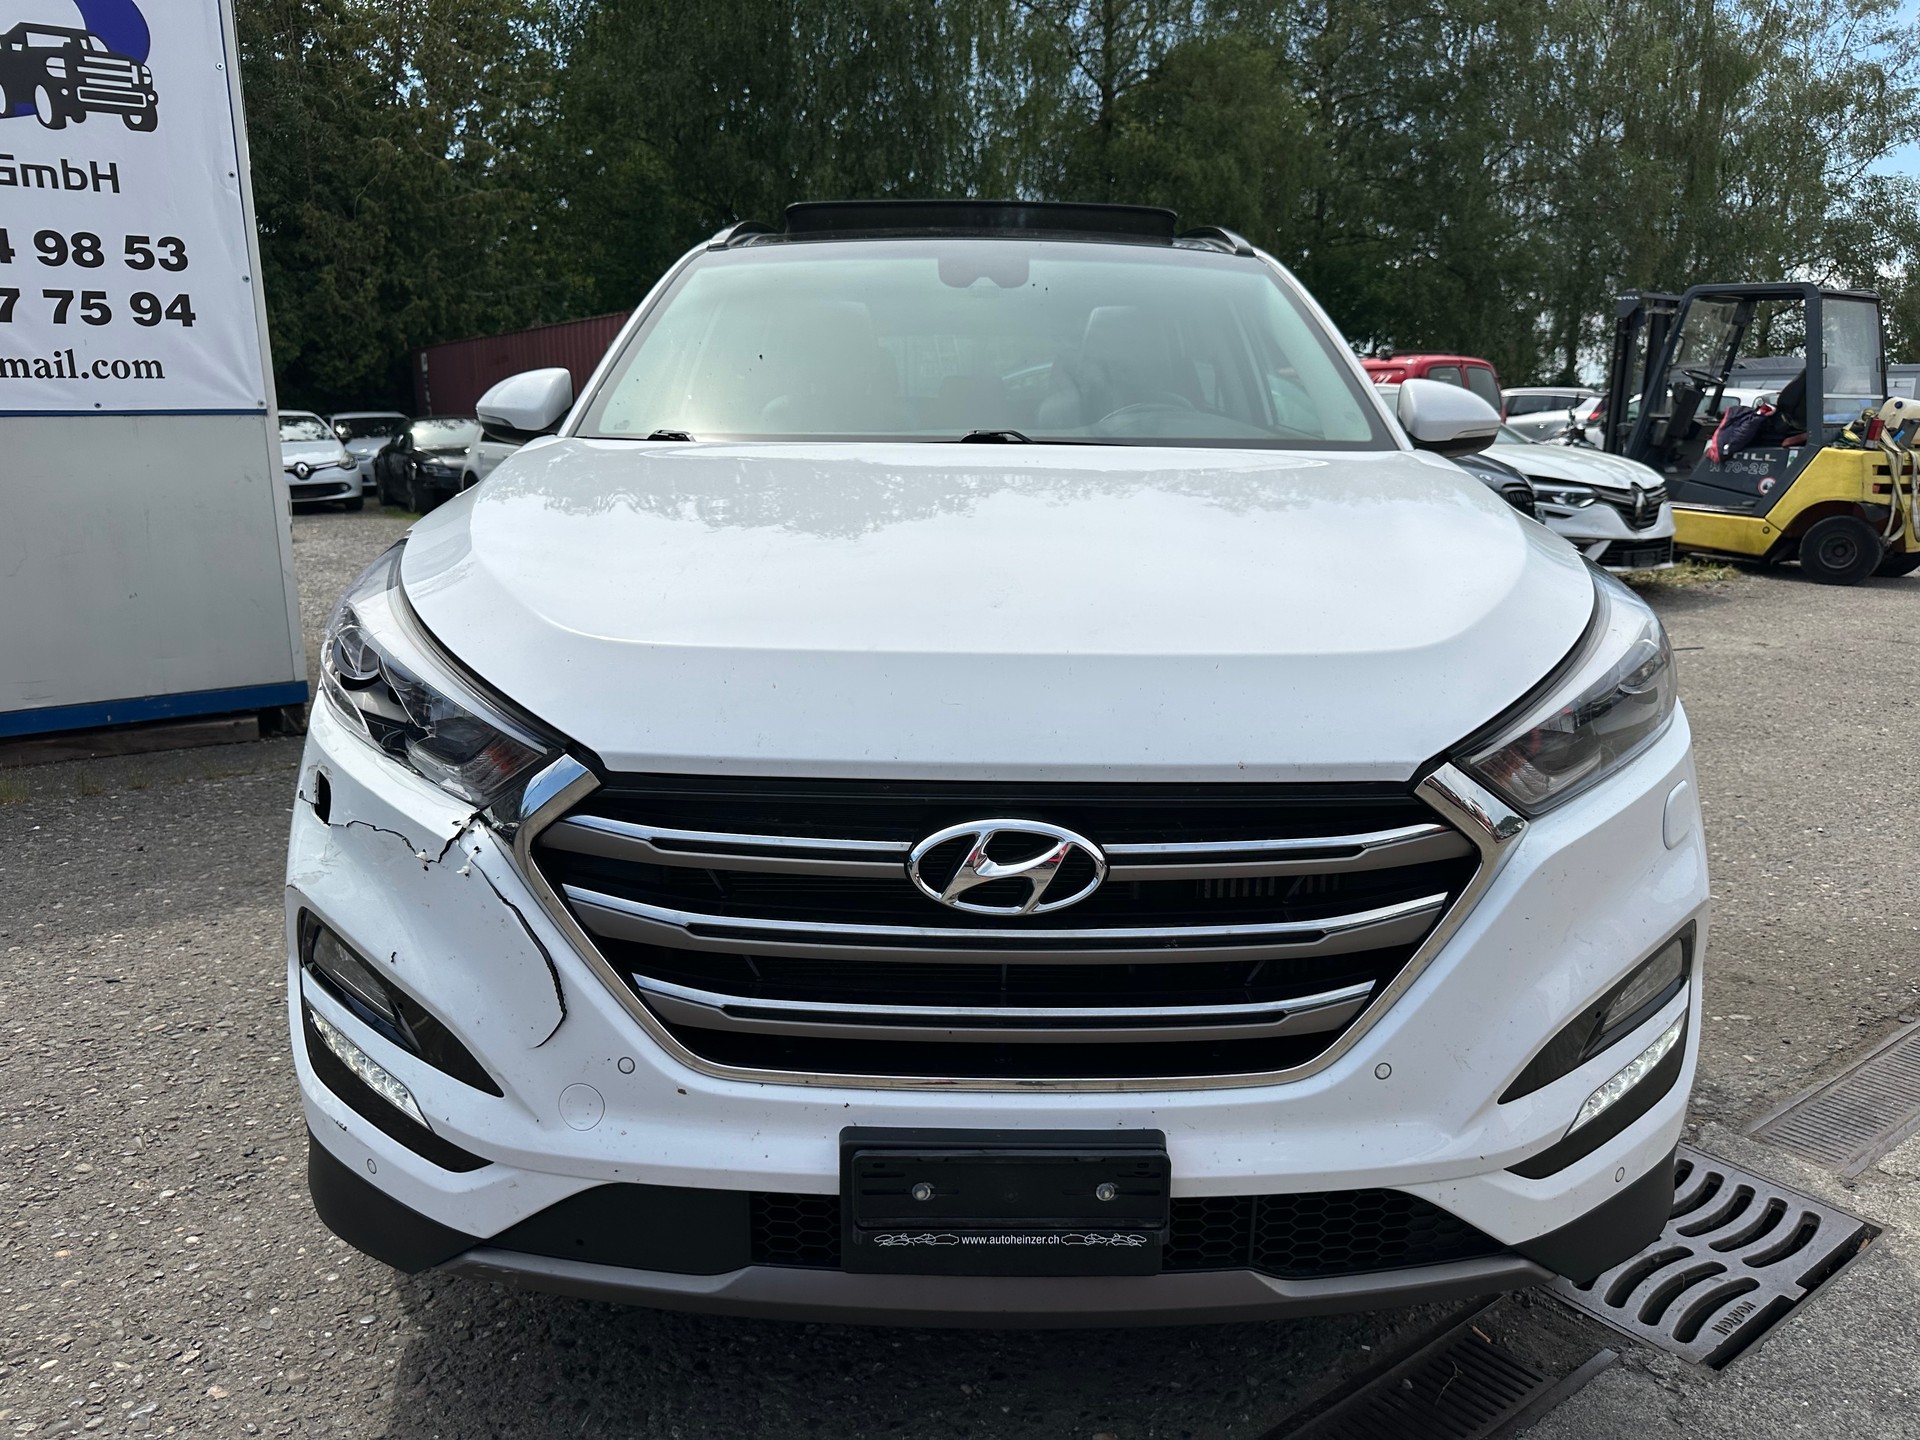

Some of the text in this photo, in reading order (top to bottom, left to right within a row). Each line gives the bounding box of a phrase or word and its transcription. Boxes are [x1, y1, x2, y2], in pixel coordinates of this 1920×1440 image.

[33, 229, 105, 268] 98
[124, 235, 189, 272] 53
[42, 289, 112, 326] 75
[129, 291, 197, 327] 94
[1724, 461, 1769, 475] 70-25
[961, 1234, 1060, 1244] www.autoheinzer.ch
